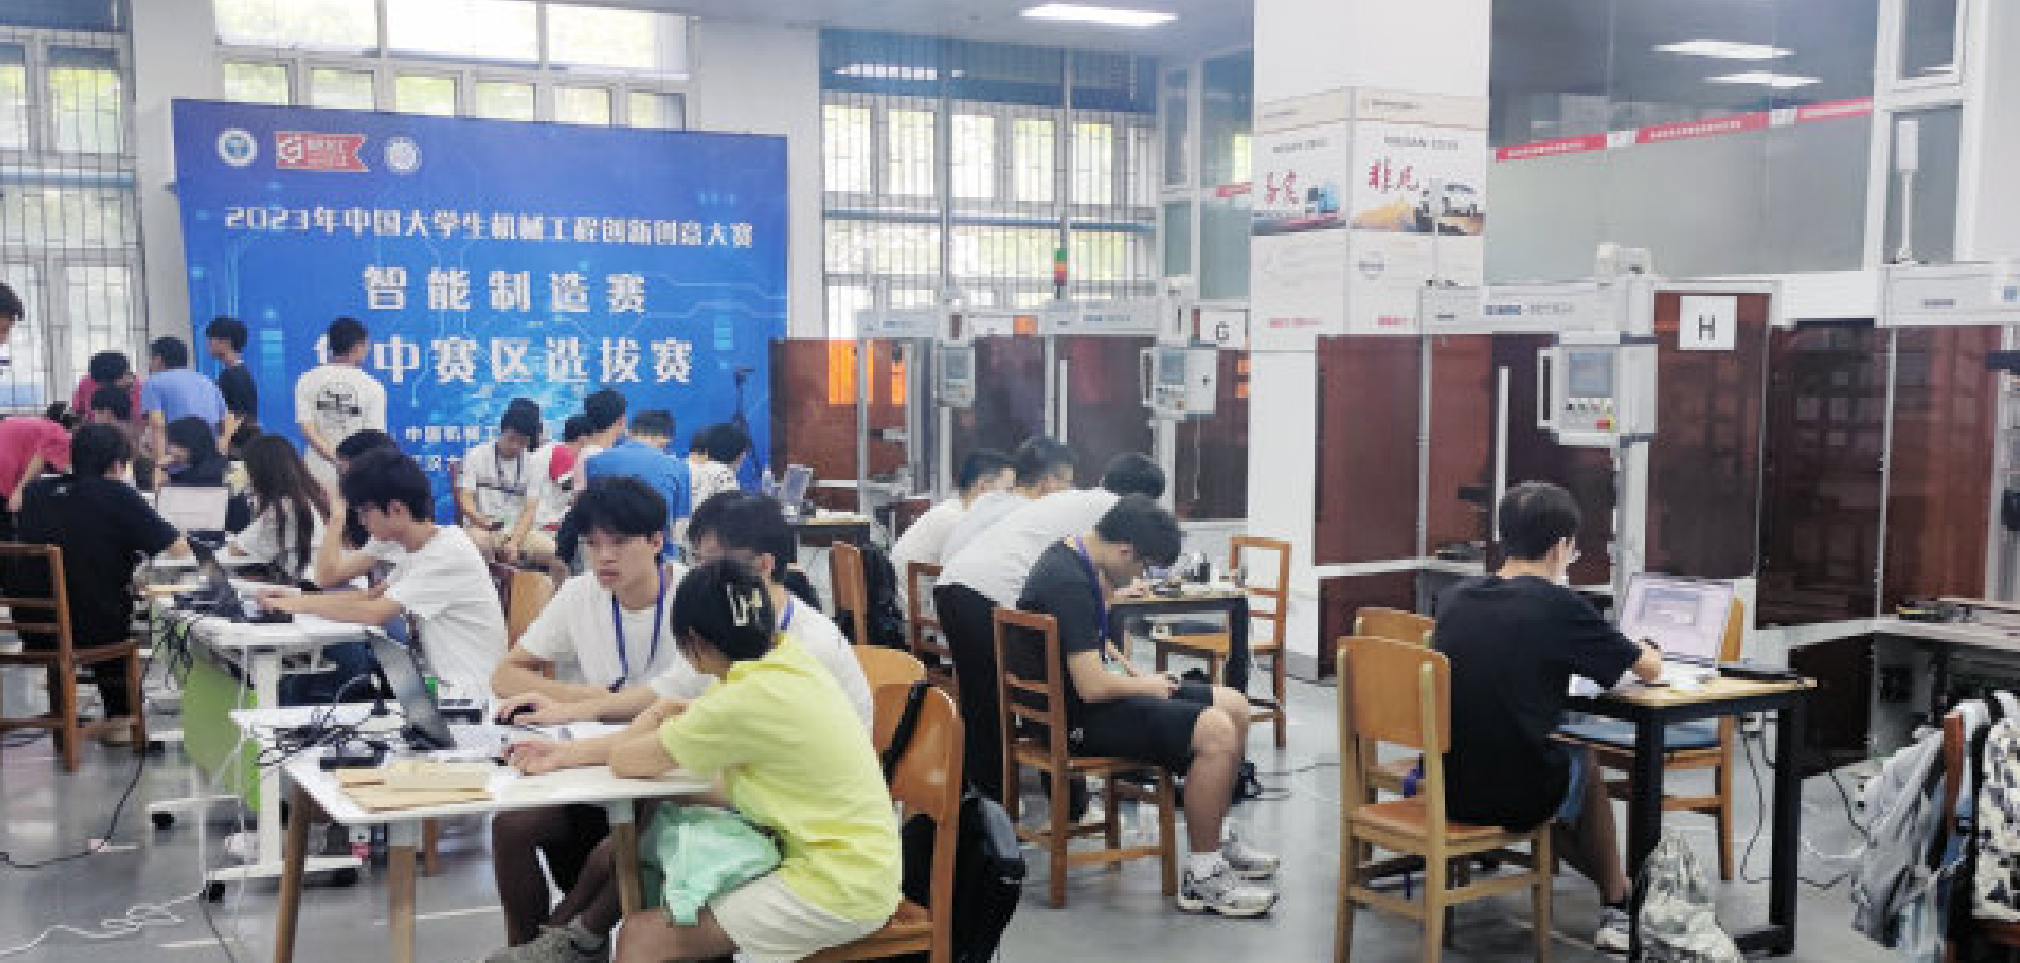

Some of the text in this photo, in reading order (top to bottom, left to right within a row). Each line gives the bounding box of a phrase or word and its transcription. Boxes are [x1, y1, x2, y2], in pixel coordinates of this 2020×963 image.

[224, 206, 754, 248] 2023年中国大学生机械工程创新创意大赛
[363, 265, 647, 314] 智能制造赛
[1215, 321, 1230, 342] G
[1697, 315, 1716, 341] H
